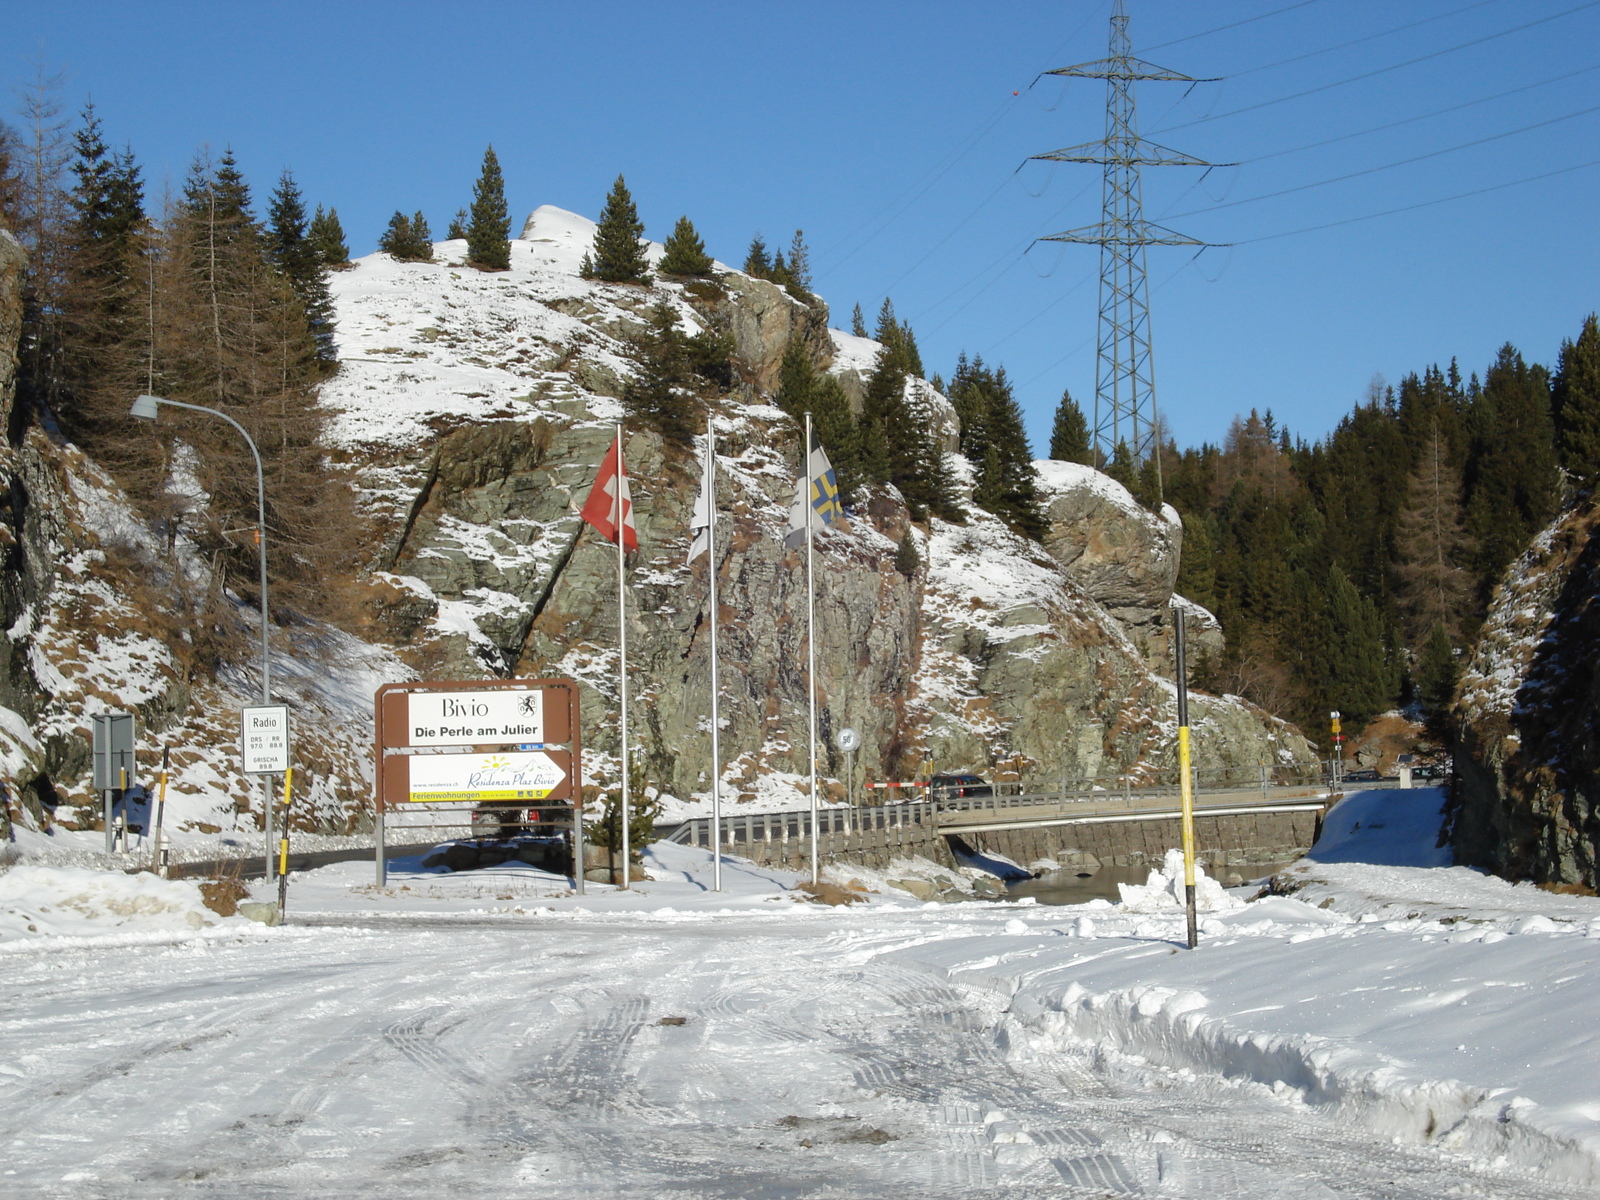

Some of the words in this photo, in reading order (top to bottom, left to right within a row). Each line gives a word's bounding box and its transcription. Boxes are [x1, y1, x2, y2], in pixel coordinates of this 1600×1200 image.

[442, 698, 489, 717] Bivio
[253, 717, 277, 728] Radio
[415, 727, 436, 737] Die
[440, 726, 473, 737] Perle
[477, 727, 497, 736] am
[501, 724, 538, 735] Julier
[467, 772, 510, 789] Residenza
[512, 772, 531, 786] Plaz
[533, 773, 555, 785] Bivio
[412, 791, 480, 800] Ferienwohnungen
